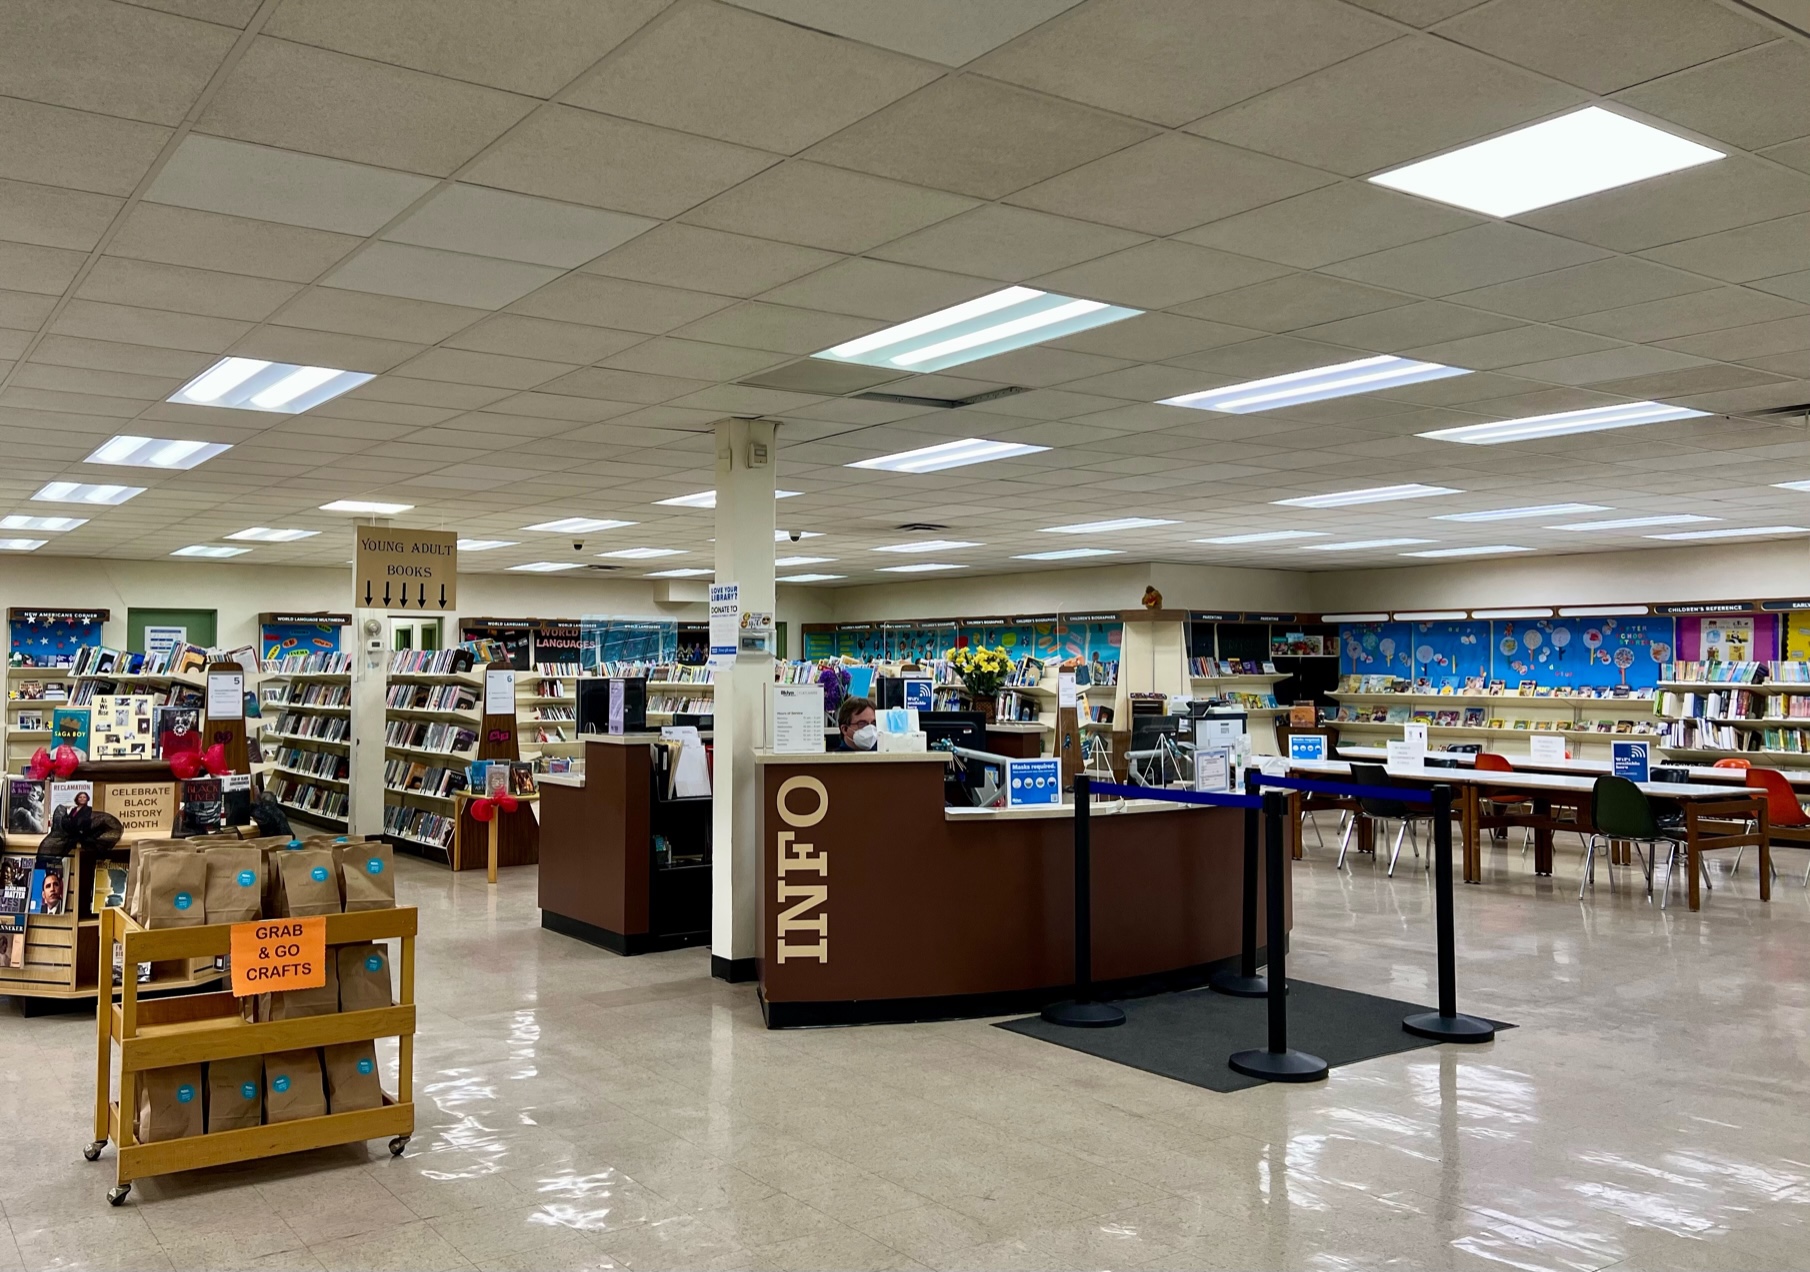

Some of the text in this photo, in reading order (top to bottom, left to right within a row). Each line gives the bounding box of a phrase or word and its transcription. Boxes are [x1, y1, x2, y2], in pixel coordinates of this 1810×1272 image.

[361, 538, 453, 556] YOUNG ADULT
[387, 564, 432, 577] BOOKS
[711, 585, 738, 594] LOVE YOUR
[711, 593, 738, 602] LIBRARY?
[711, 604, 738, 614] DONATE TO
[1705, 604, 1742, 612] REFERENCE
[541, 629, 579, 637] WORLD
[536, 639, 596, 649] LANGUAGES
[234, 676, 240, 685] 5
[507, 675, 512, 683] 6
[1031, 763, 1056, 771] required.
[111, 787, 171, 796] CELEBRATE
[124, 798, 158, 807] BLACK
[119, 809, 162, 818] HISTORY
[122, 820, 159, 829] MONTH
[777, 775, 829, 964] INFO
[4, 891, 26, 899] MATTER
[256, 924, 303, 940] GRAB
[258, 944, 300, 959] & GO
[246, 962, 312, 981] CRAFTS
